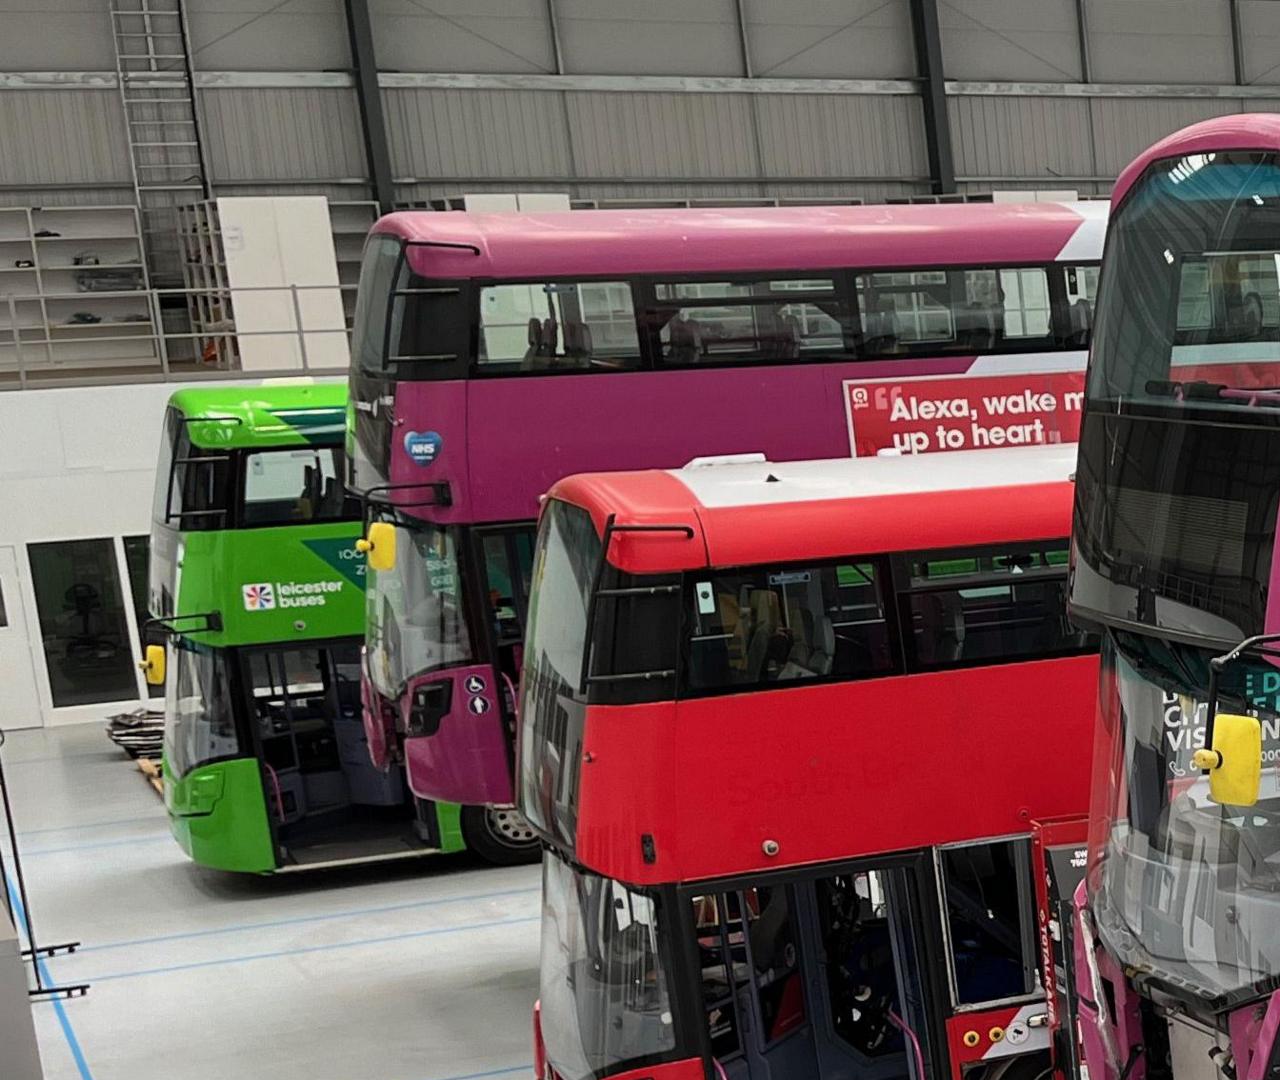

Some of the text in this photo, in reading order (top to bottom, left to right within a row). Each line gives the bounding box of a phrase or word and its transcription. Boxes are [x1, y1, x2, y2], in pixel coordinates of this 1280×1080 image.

[890, 390, 1084, 422] Alexa, wake m
[893, 419, 1044, 455] up to heart
[411, 443, 435, 454] NHS
[276, 581, 343, 597] leicester
[280, 595, 326, 608] buses
